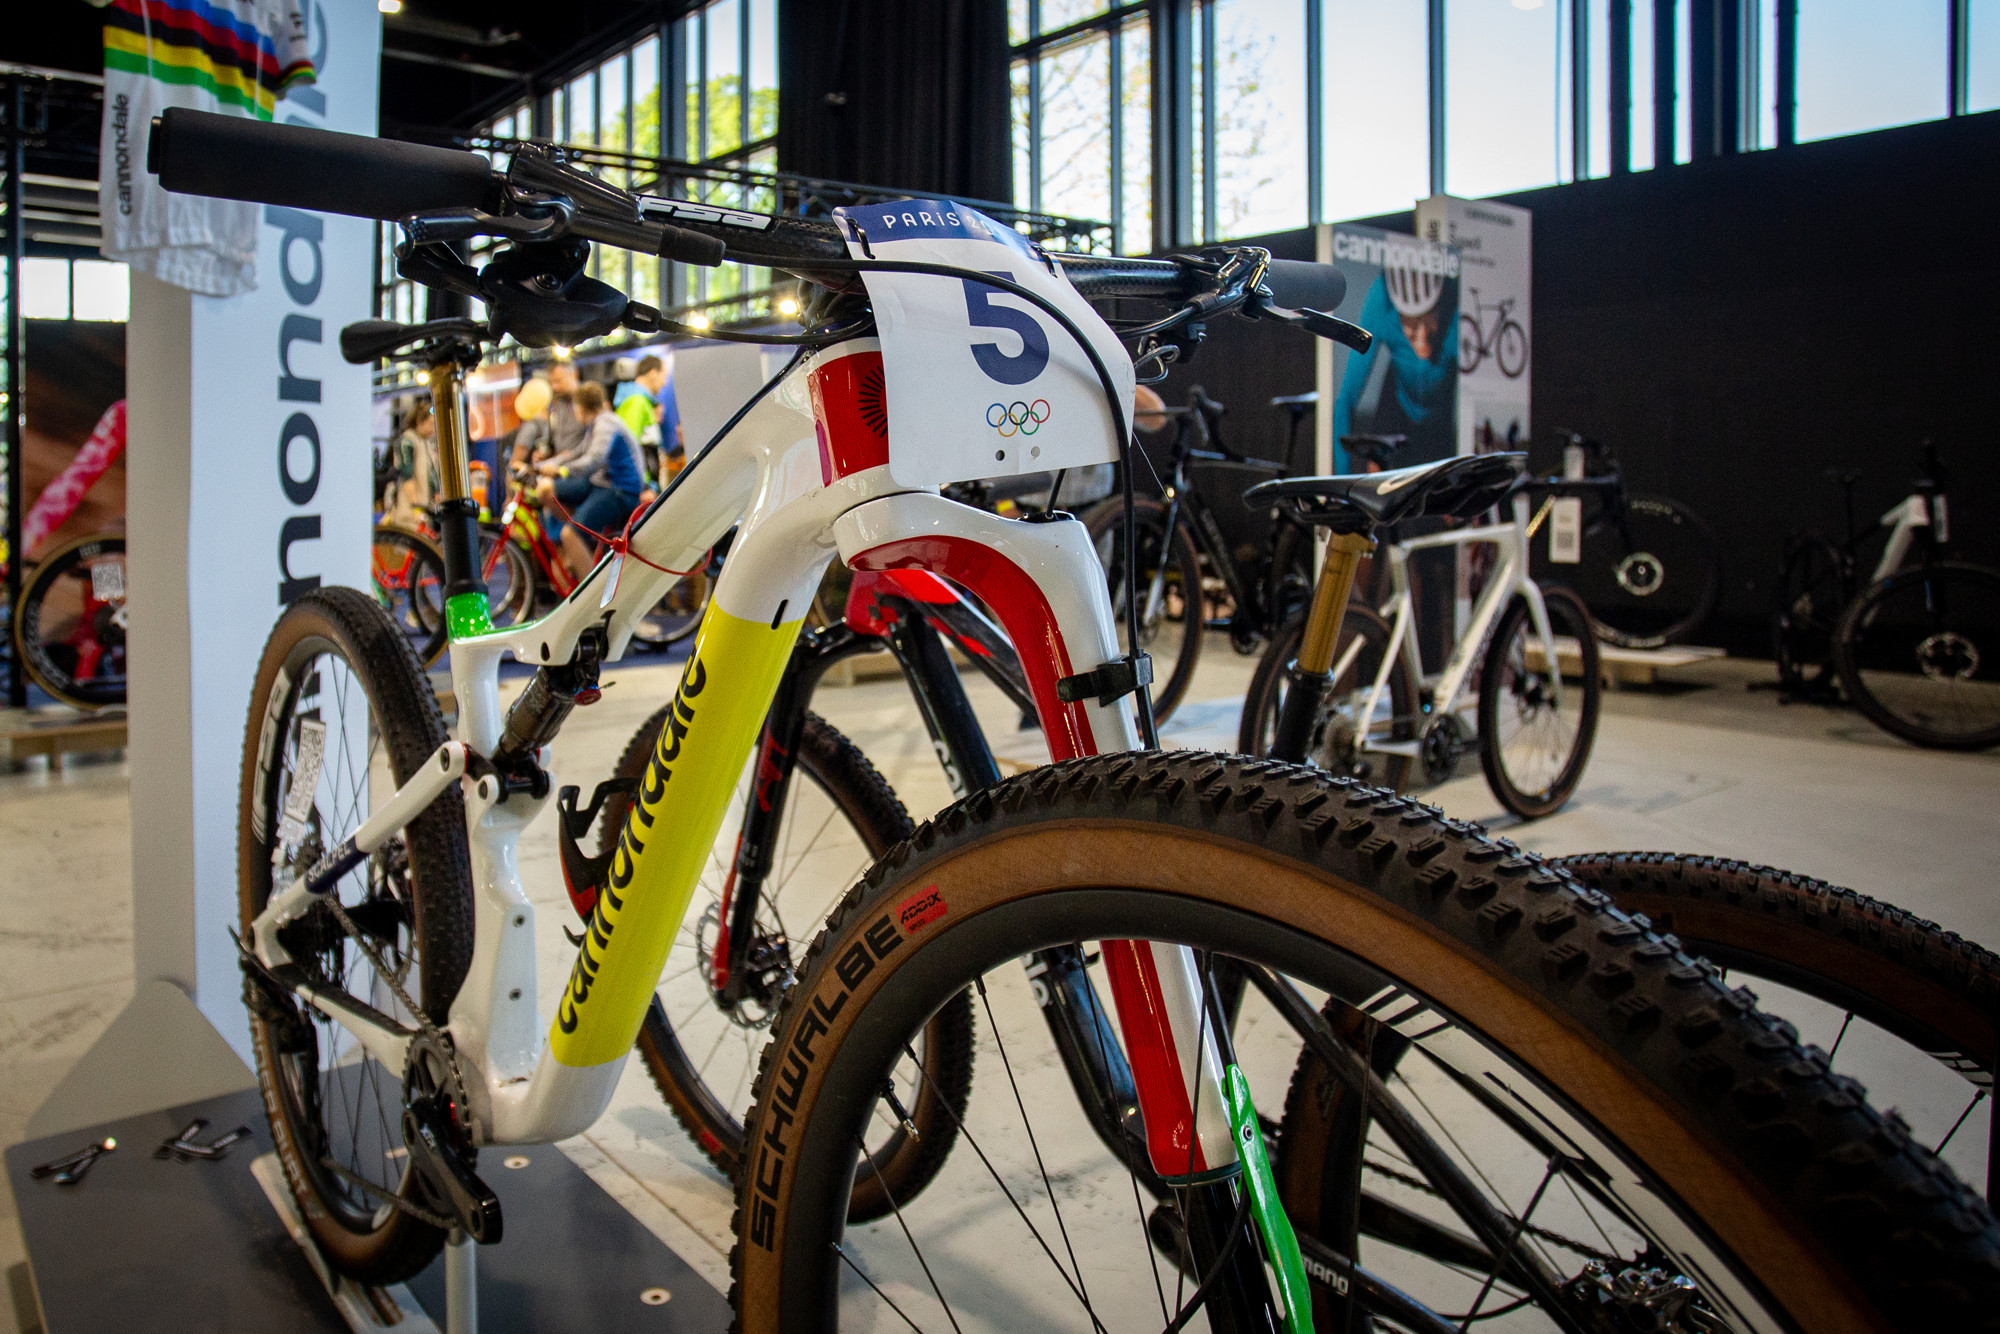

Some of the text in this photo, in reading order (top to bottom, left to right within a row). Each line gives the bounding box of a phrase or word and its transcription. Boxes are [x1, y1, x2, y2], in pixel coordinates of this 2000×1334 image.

[112, 93, 133, 216] cannondale
[1333, 230, 1460, 279] cannondale
[961, 270, 1050, 386] 5
[308, 842, 352, 884] SCALPEL
[558, 650, 708, 1035] cannondale
[901, 891, 942, 925] ADDIX
[752, 914, 904, 1253] SCHWALBE
